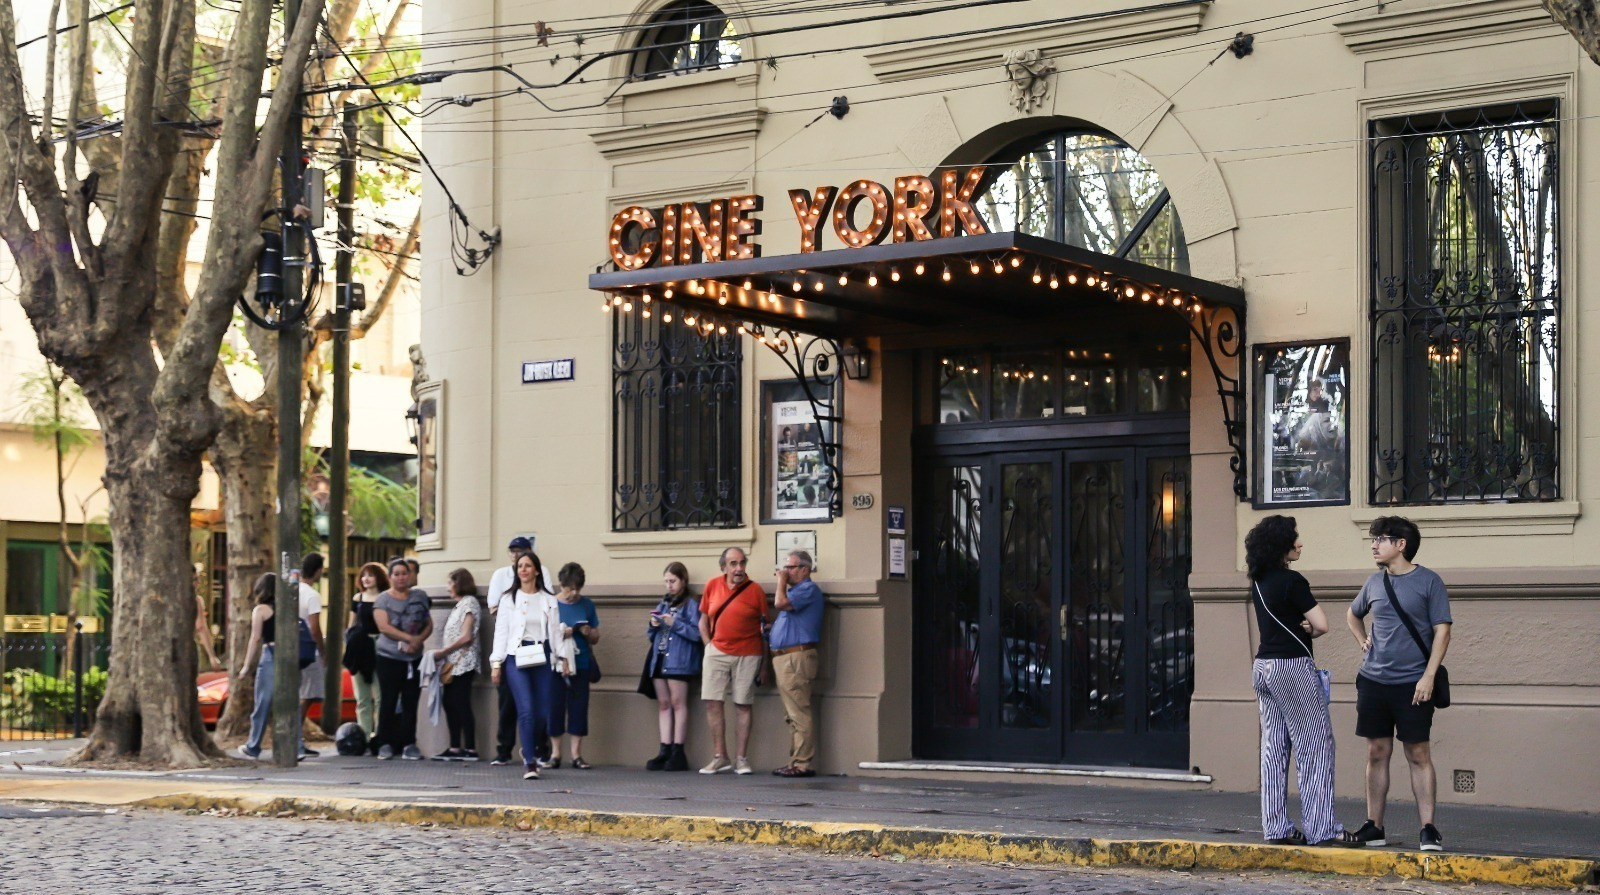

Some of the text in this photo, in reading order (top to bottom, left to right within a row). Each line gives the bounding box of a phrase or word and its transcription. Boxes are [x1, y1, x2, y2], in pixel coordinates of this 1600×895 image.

[609, 166, 988, 271] CINE YORK
[852, 495, 871, 507] 895
